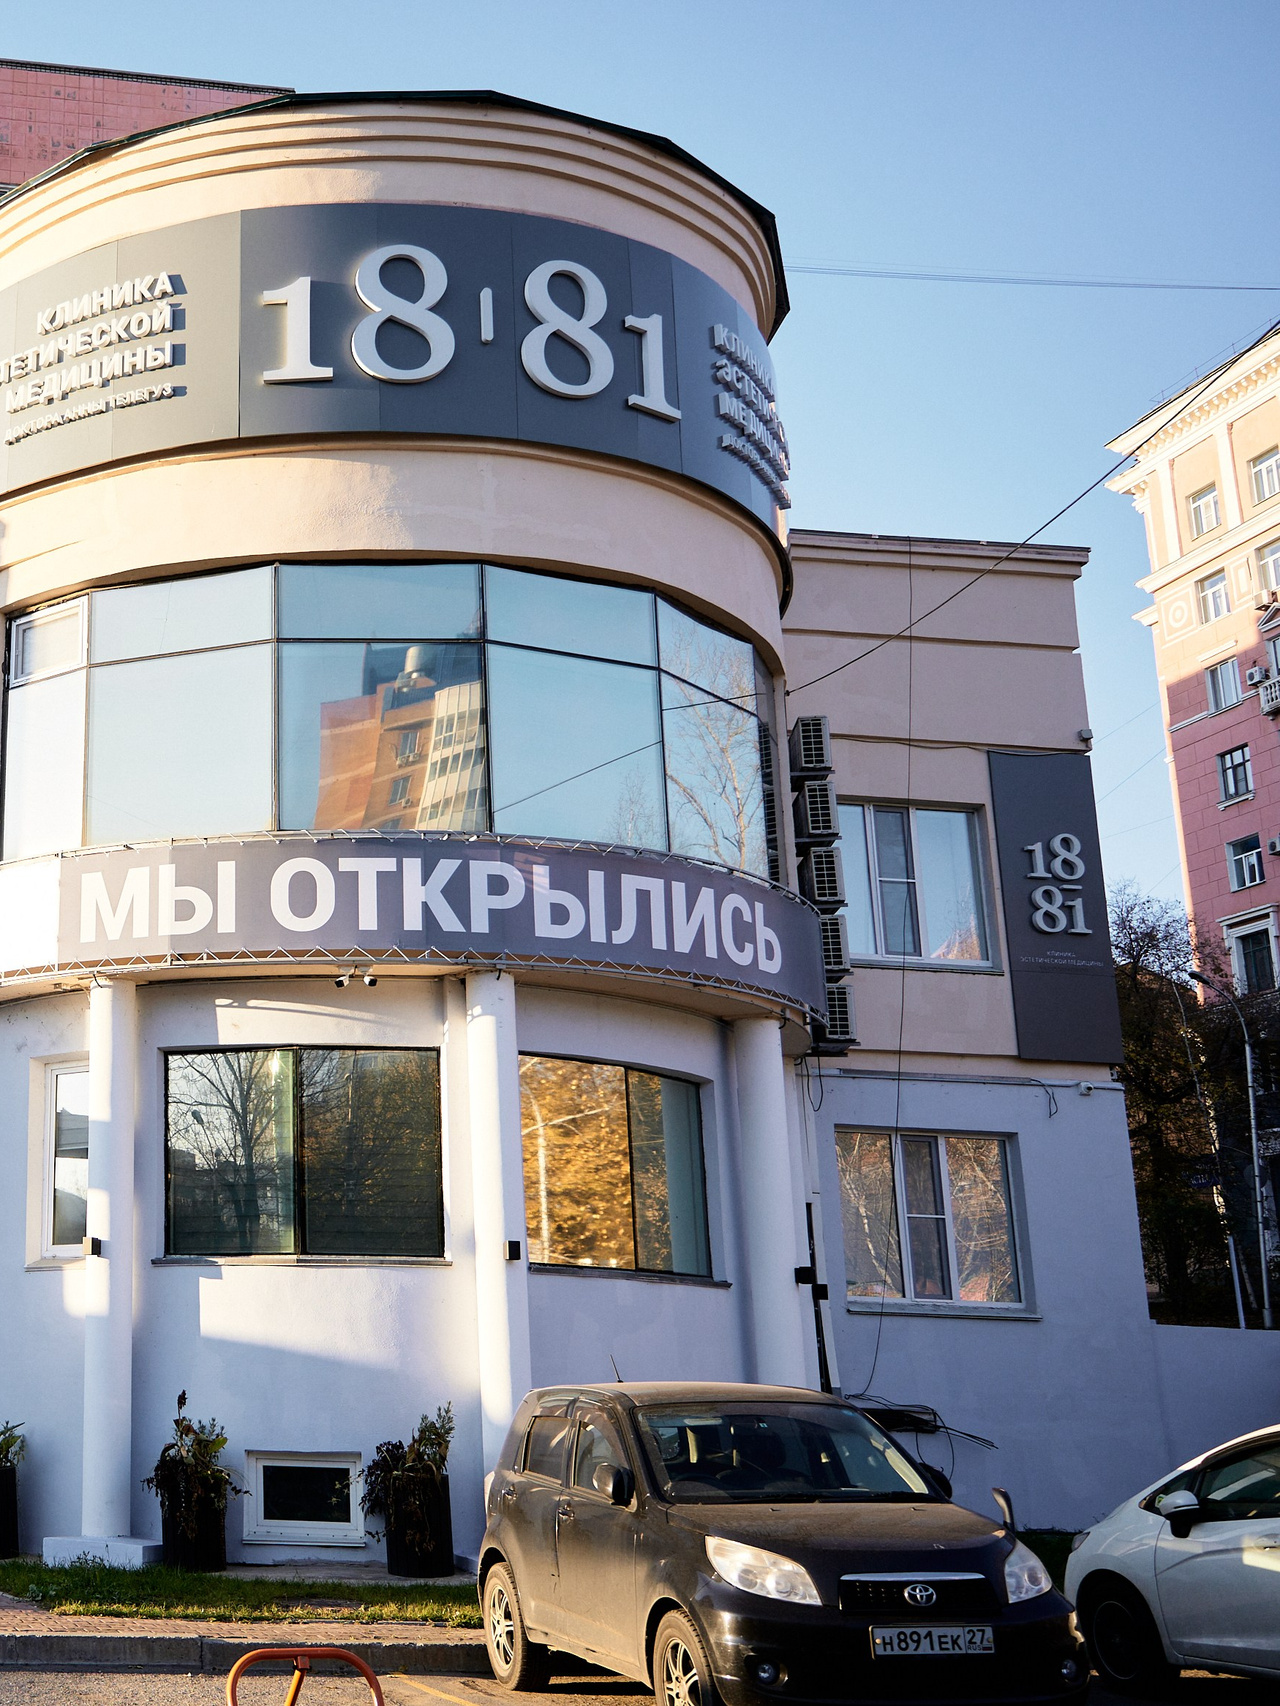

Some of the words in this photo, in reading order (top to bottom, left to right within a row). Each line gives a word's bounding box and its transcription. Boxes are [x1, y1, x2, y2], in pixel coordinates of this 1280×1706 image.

[37, 271, 175, 336] КЛИНИКА
[5, 340, 173, 414] МЕДИЦИНЫ
[4, 411, 63, 445] ДОКТОРА
[63, 399, 105, 423] АННЫ
[106, 382, 173, 408] ТЕЛЕГУЗ
[1023, 833, 1086, 881] 18
[79, 860, 237, 944] МЫ
[269, 856, 782, 974] ОТКРЫЛИСЬ
[1031, 885, 1093, 935] 81
[967, 1629, 986, 1645] 27
